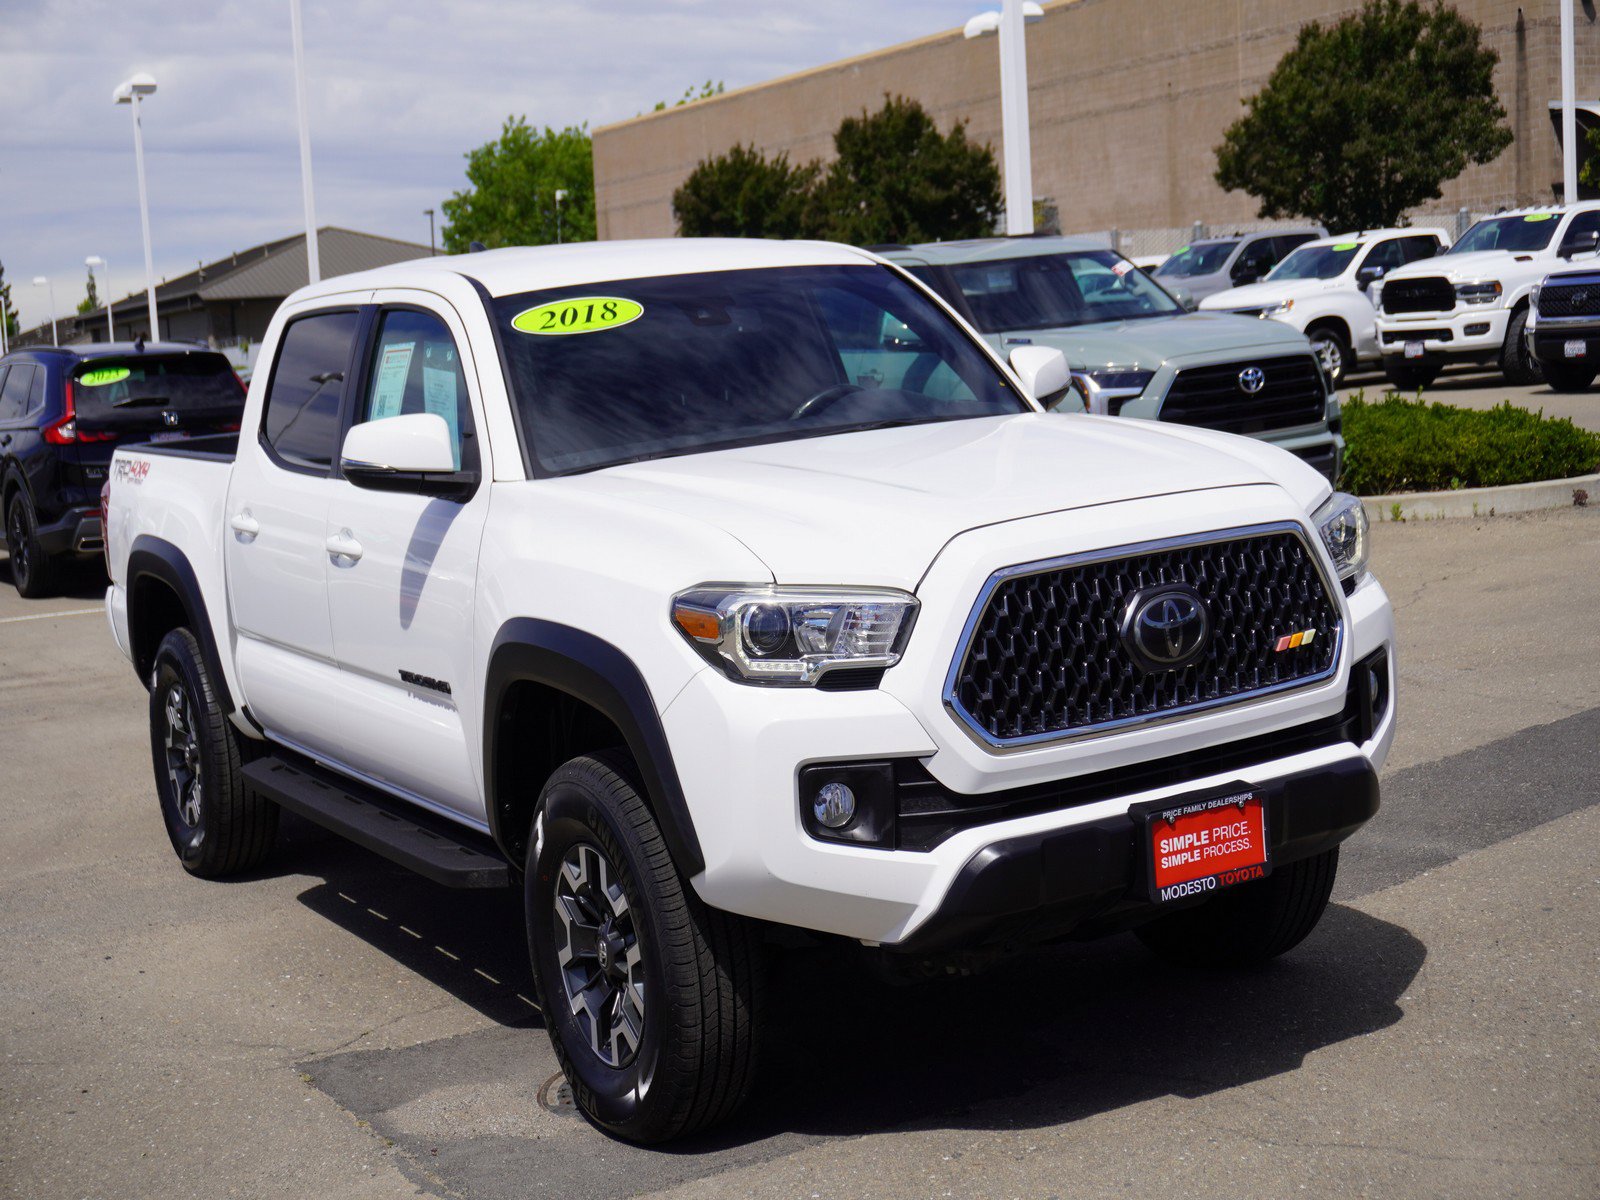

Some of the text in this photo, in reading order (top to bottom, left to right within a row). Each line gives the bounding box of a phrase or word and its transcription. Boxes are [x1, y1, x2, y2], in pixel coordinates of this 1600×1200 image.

[539, 301, 618, 331] 2018
[1162, 792, 1253, 819] PRICE FAMILY DEALERSHIPS
[1160, 821, 1251, 854] SIMPLE PRICE.
[1161, 838, 1253, 869] SIMPLE PROCESS.
[1161, 866, 1264, 902] MODESTO TOYOTA
